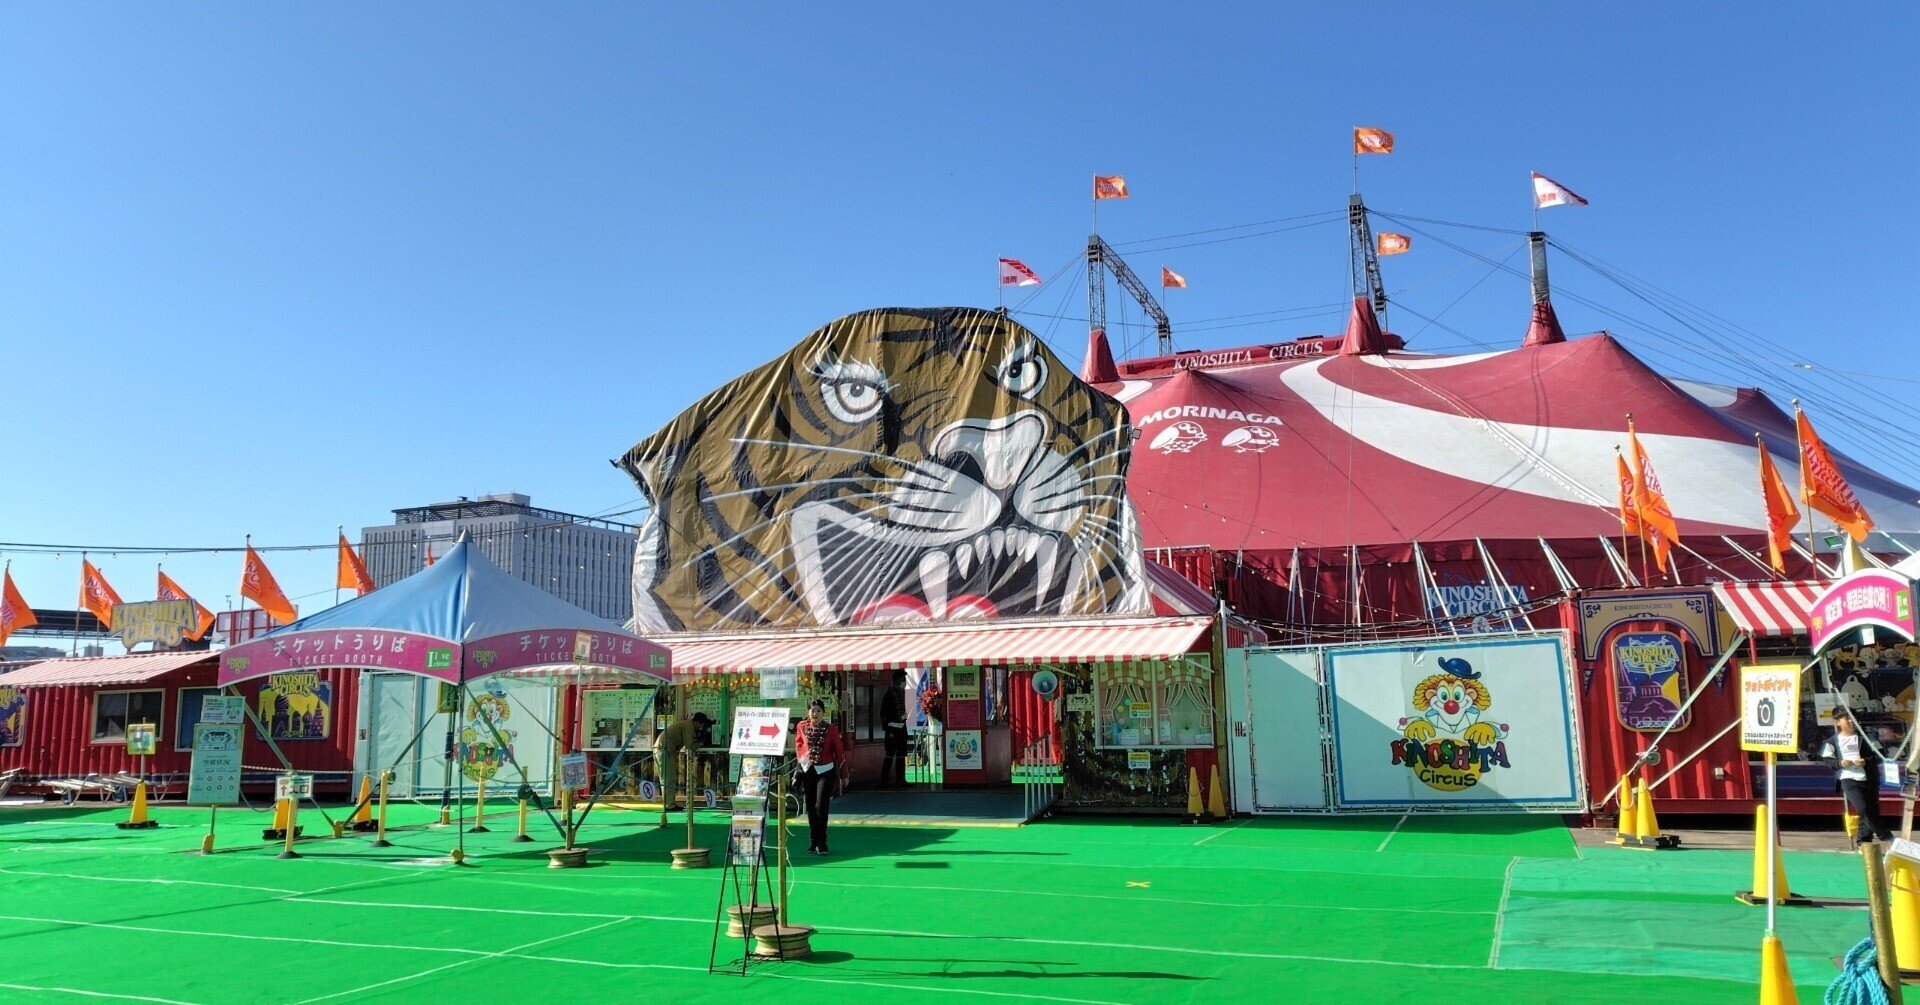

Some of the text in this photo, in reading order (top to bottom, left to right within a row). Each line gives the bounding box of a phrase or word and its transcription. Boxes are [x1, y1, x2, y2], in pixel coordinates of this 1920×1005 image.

[1174, 341, 1323, 370] KINOSHITA CIRCUS
[1138, 405, 1283, 427] MORINAGA
[110, 600, 196, 634] KINOSHITA
[123, 620, 180, 646] CIRCUS
[273, 633, 407, 657] チケットうりば
[519, 633, 633, 654] チケッうりば
[1621, 646, 1678, 660] KINOSHITA
[289, 654, 383, 667] TICKET BOOTH
[1631, 654, 1666, 664] CIRCUS
[272, 673, 319, 690] KINOSHITA
[280, 684, 310, 697] CIRCUS
[1745, 679, 1792, 692] フォトポイント
[1390, 738, 1511, 773] KINOSHITA
[1420, 769, 1477, 787] Circus
